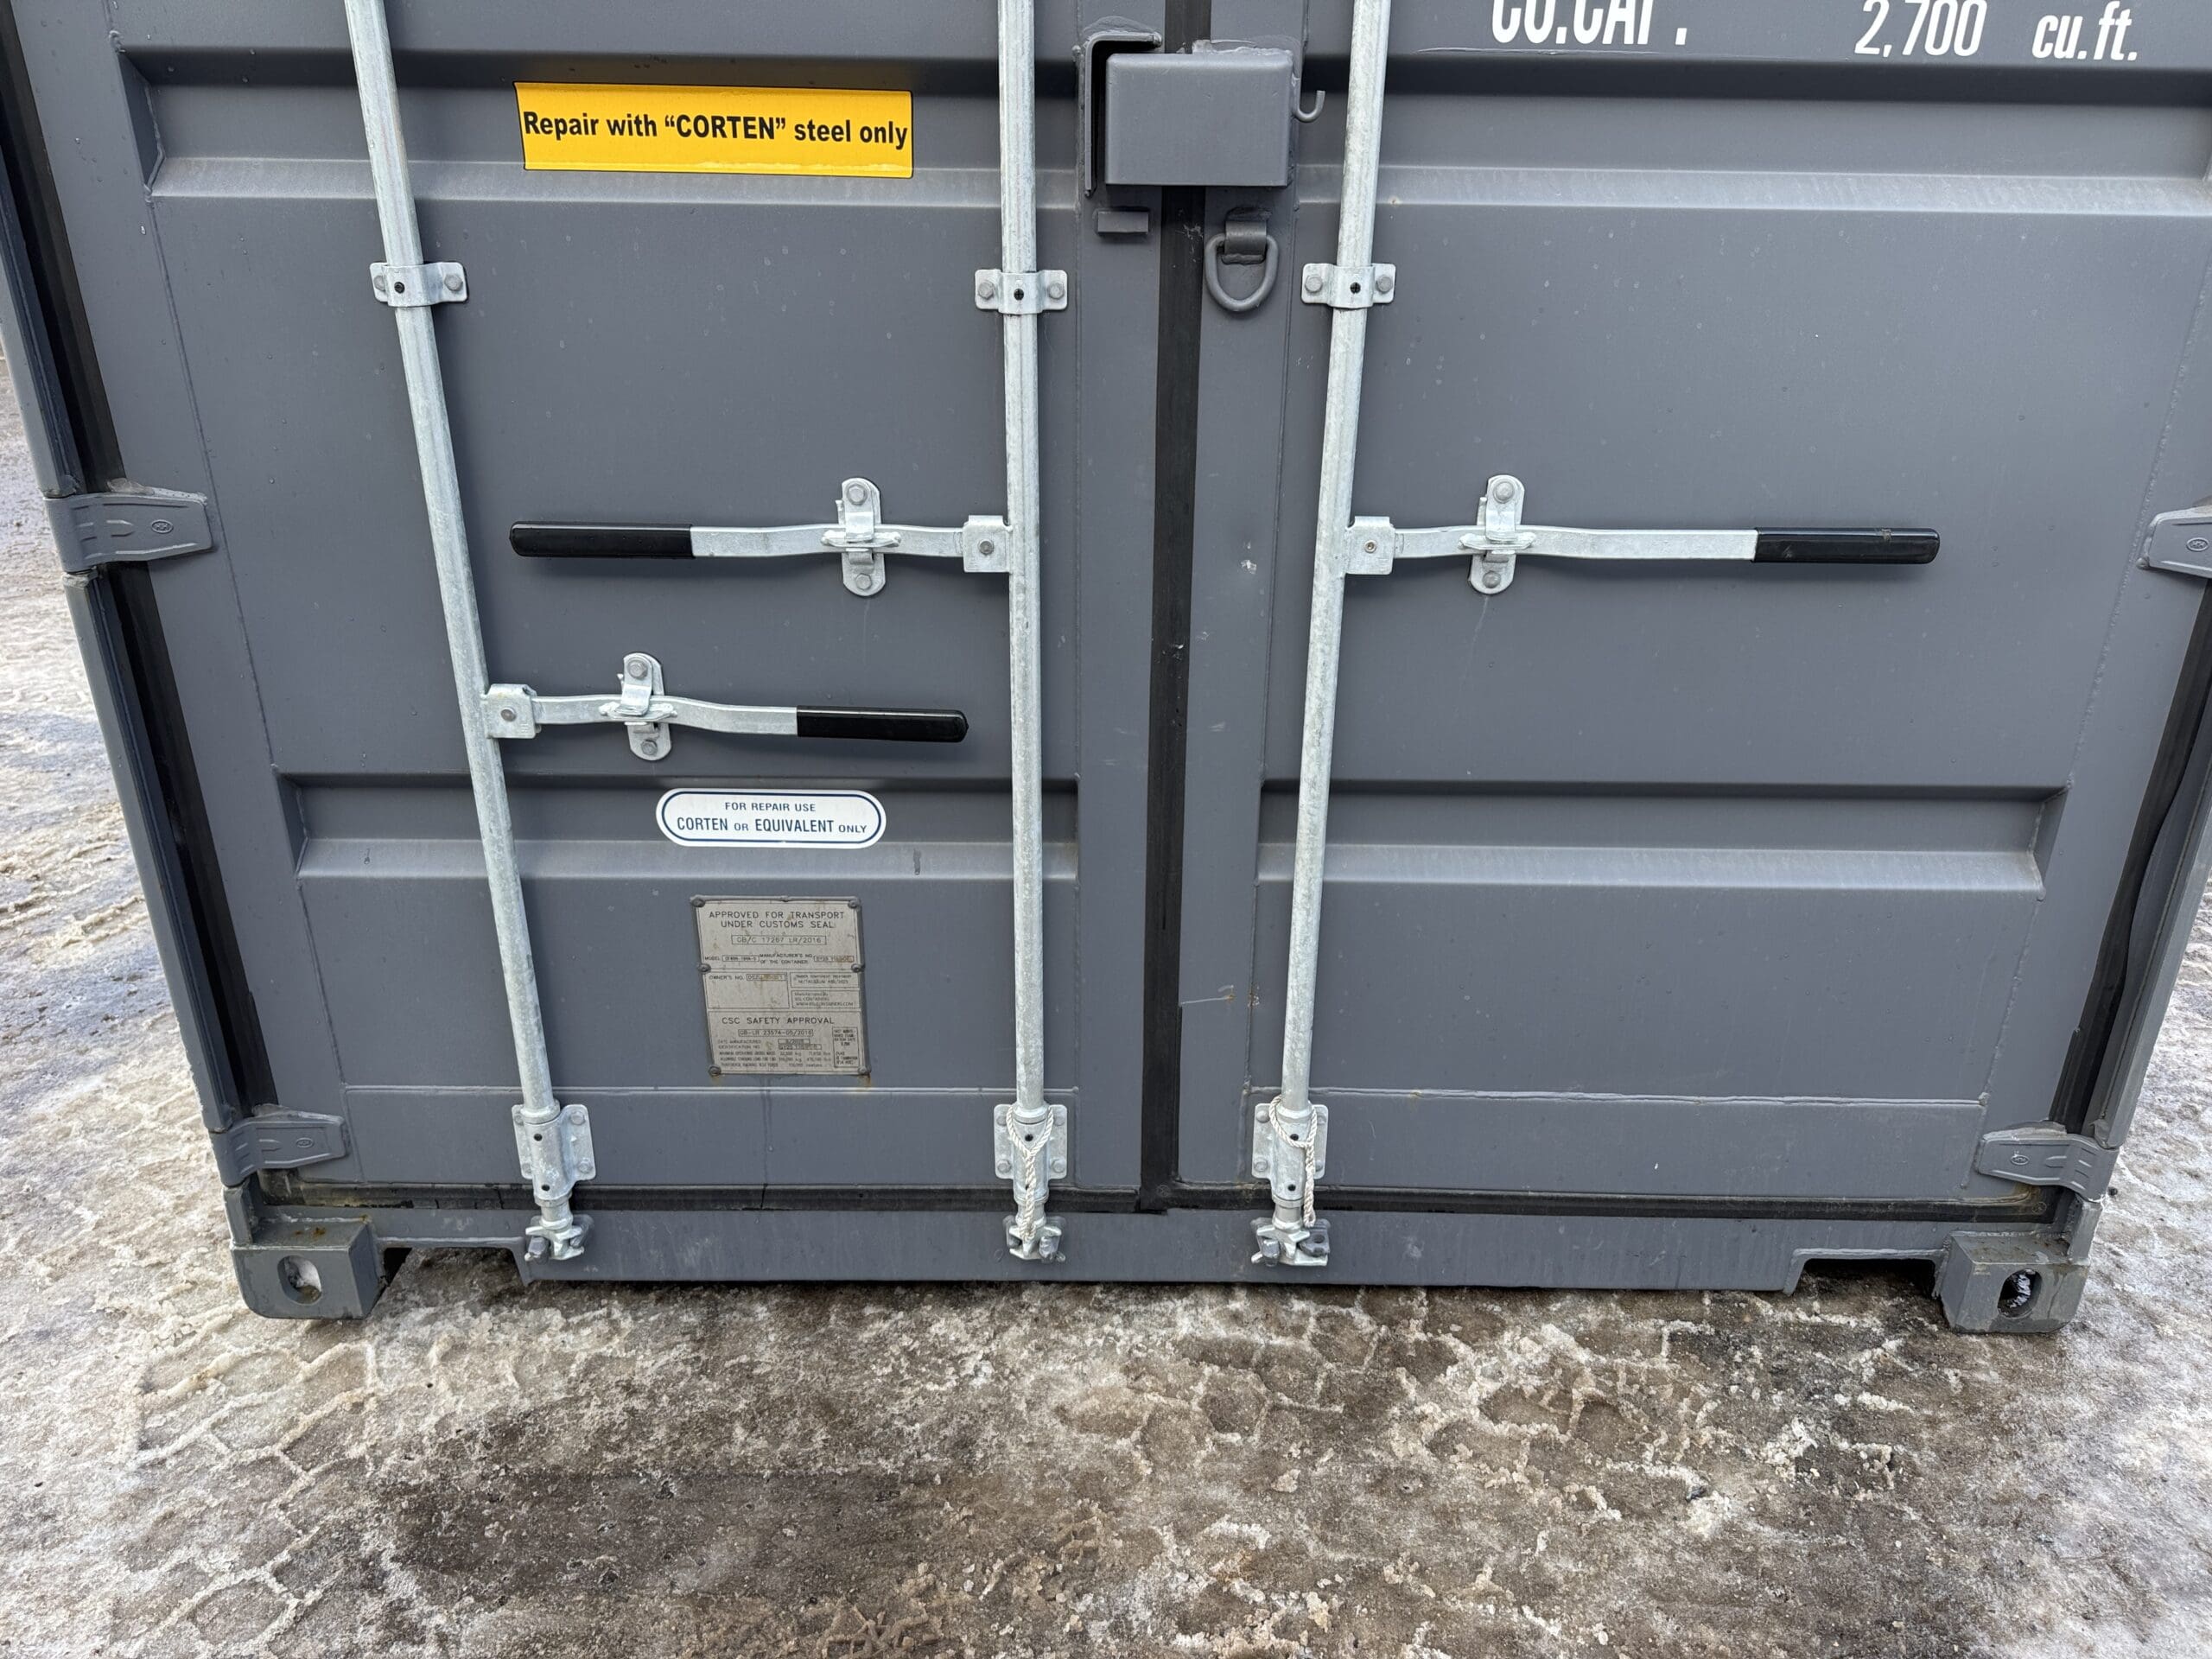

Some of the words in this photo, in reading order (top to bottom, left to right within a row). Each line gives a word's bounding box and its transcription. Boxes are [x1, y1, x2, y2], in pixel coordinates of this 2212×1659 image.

[1854, 0, 1987, 57] 2,700
[2031, 0, 2138, 60] cu.ft.
[523, 111, 600, 141] Repair
[607, 113, 658, 137] with
[664, 114, 786, 140] “CORTEN”
[793, 119, 851, 143] steel
[859, 121, 908, 150] only
[725, 802, 747, 811] FOR
[751, 803, 790, 812] REPAIR
[795, 803, 816, 812] USE
[677, 817, 728, 831] CORTEN
[734, 823, 749, 831] OR
[755, 818, 835, 833] EQUIVALENT
[838, 824, 868, 834] ONLY
